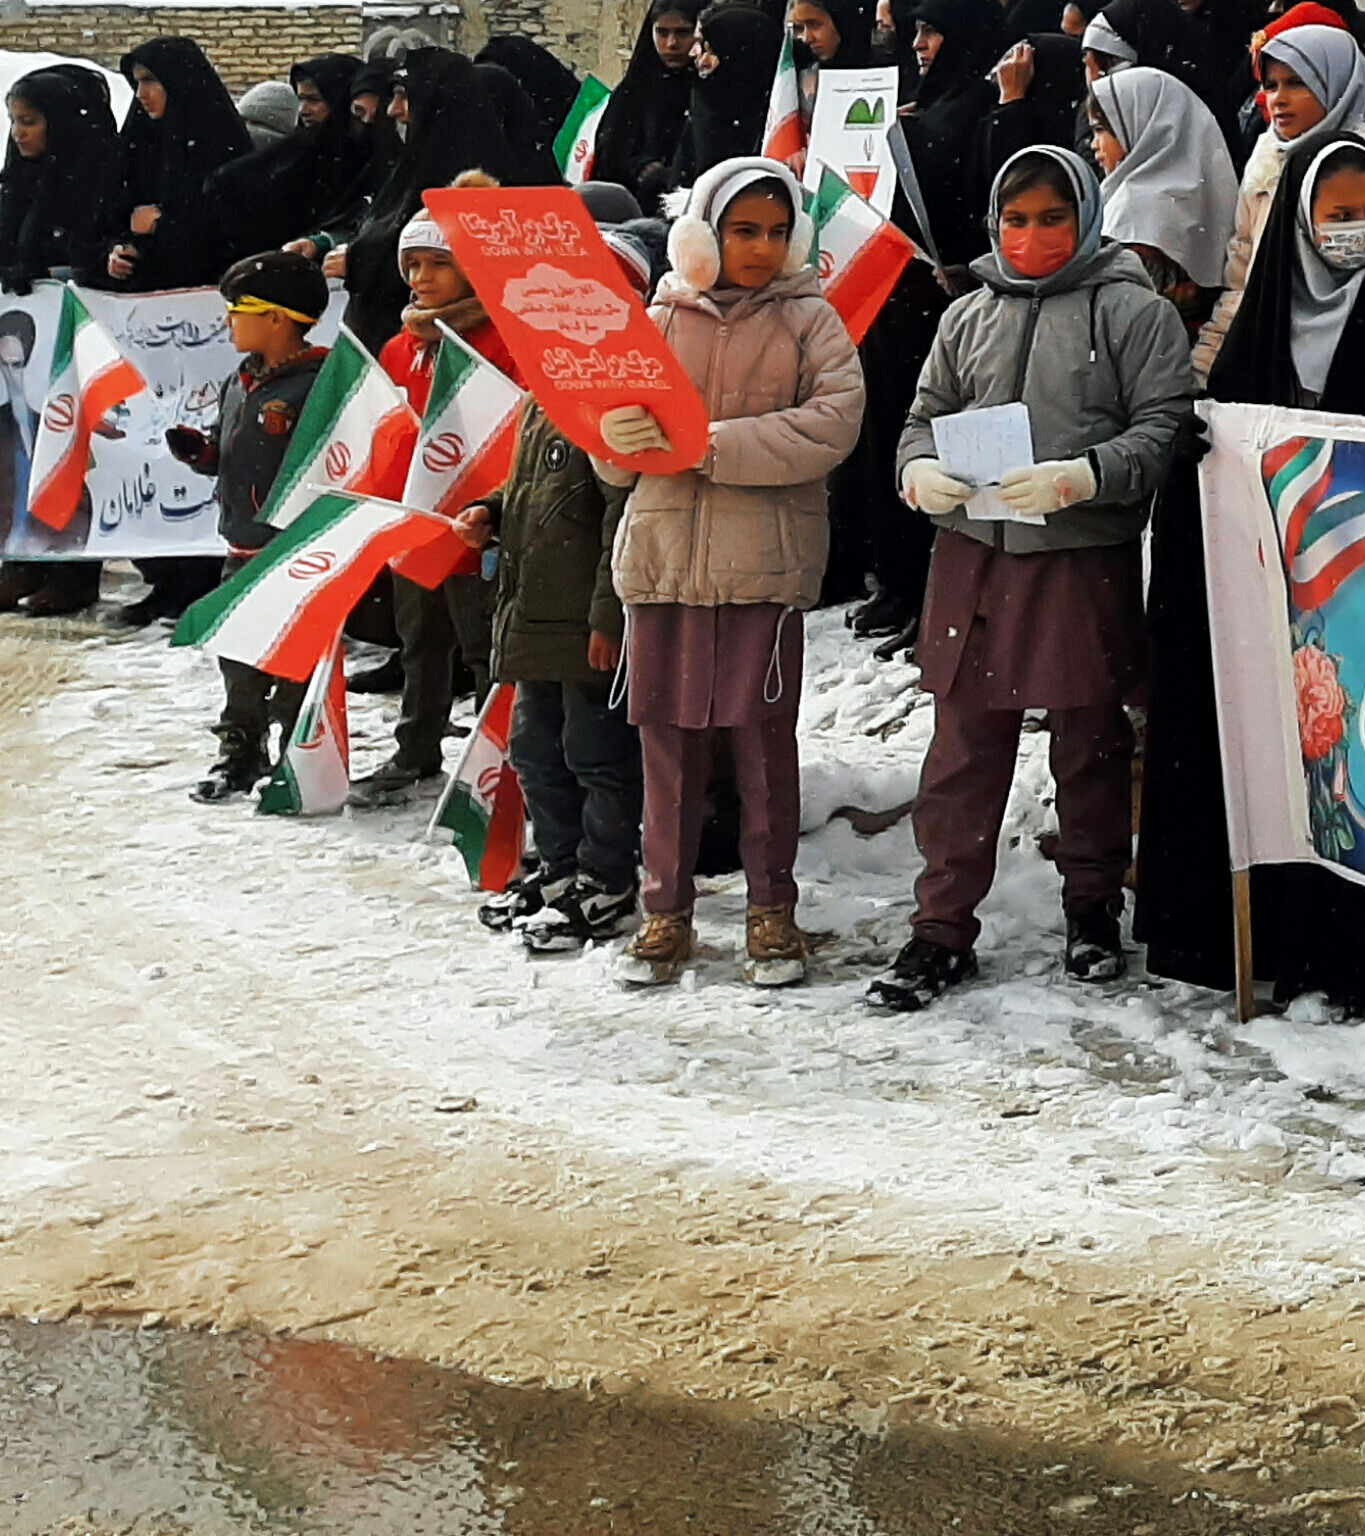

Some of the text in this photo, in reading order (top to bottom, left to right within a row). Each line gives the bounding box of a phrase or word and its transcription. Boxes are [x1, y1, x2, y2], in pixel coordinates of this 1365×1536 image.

[522, 218, 545, 245] بر
[541, 212, 581, 245] مرگ
[607, 354, 628, 379] بر
[624, 349, 663, 379] مرگ
